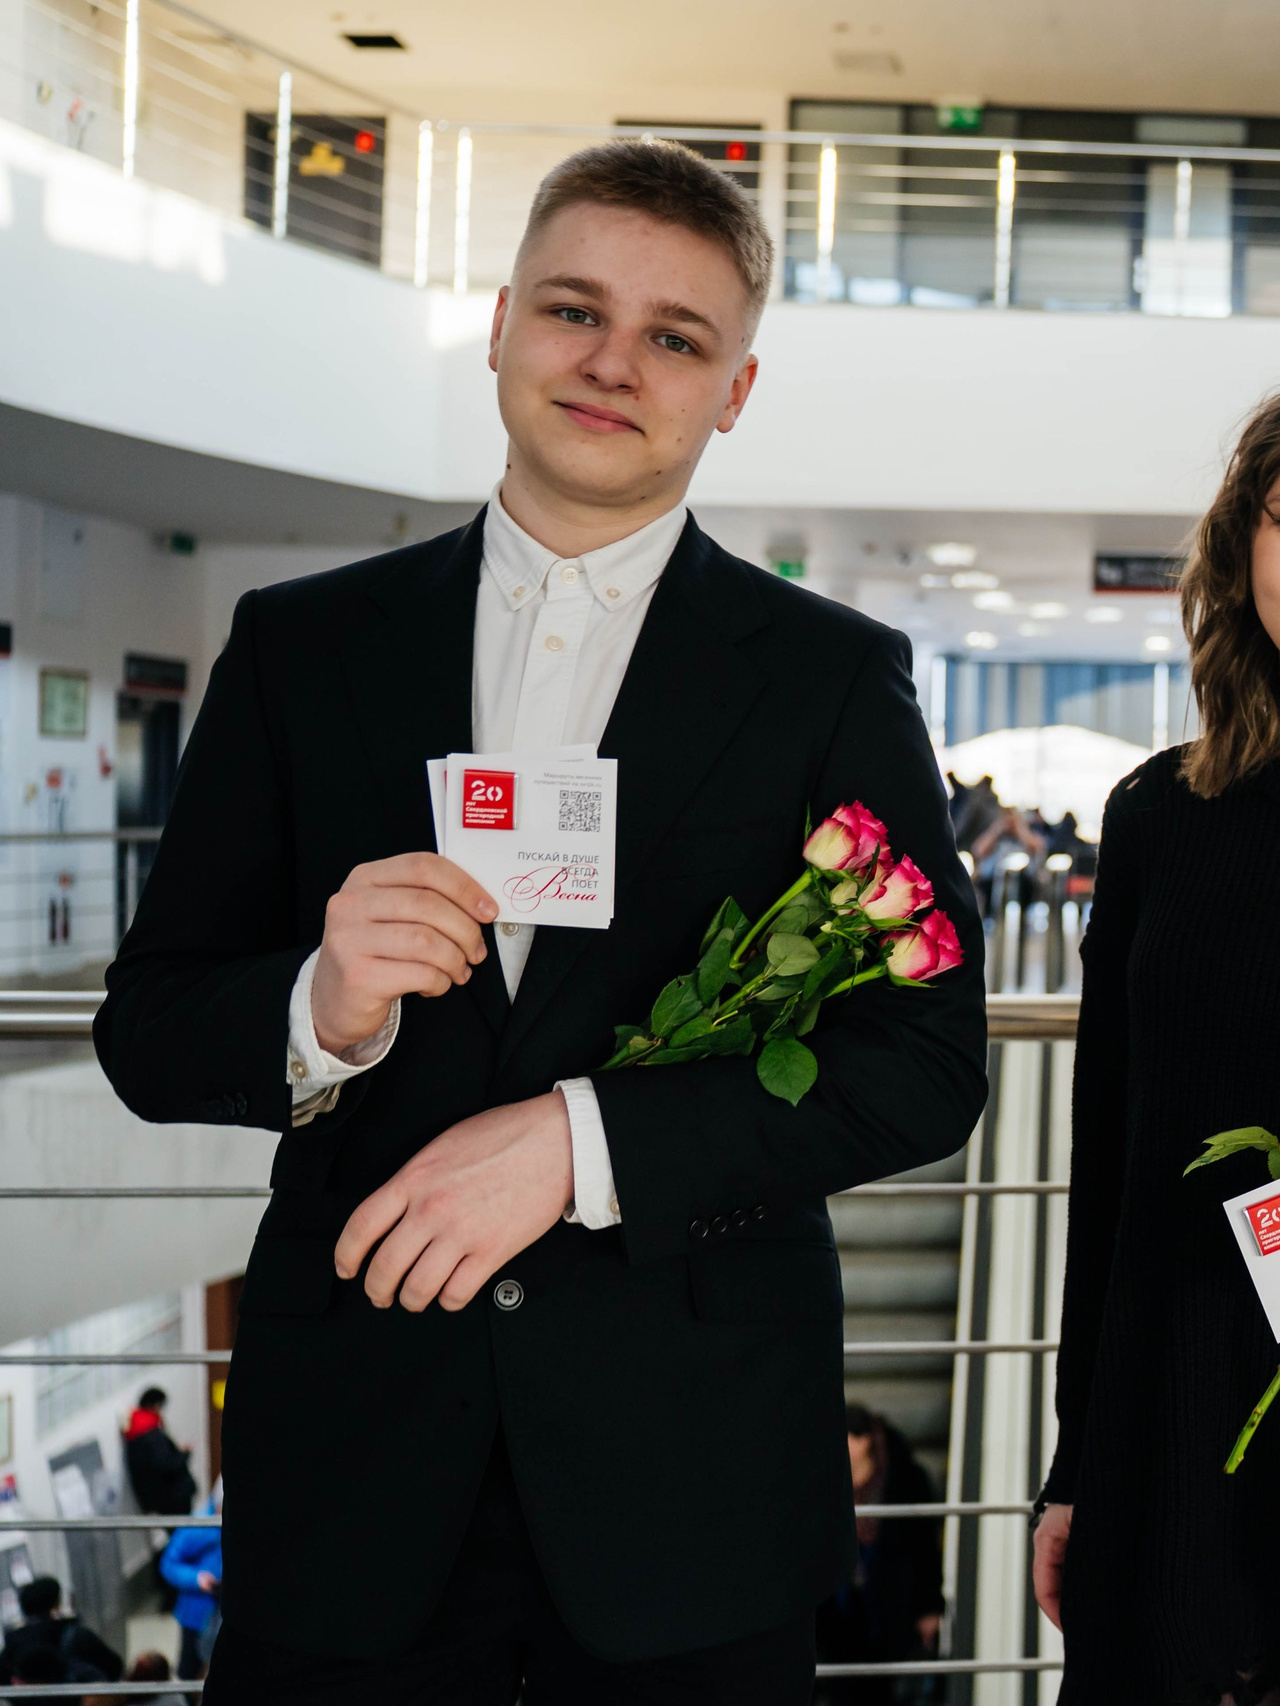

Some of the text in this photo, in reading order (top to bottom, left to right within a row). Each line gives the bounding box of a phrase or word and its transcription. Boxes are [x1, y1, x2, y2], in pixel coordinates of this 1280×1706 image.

[471, 779, 503, 801] 20
[518, 851, 599, 864] ПУСКАЙ В ДУШЕ
[561, 866, 599, 877] ВСЕГДА
[503, 863, 598, 914] Весна
[571, 879, 599, 889] ПОЕТ
